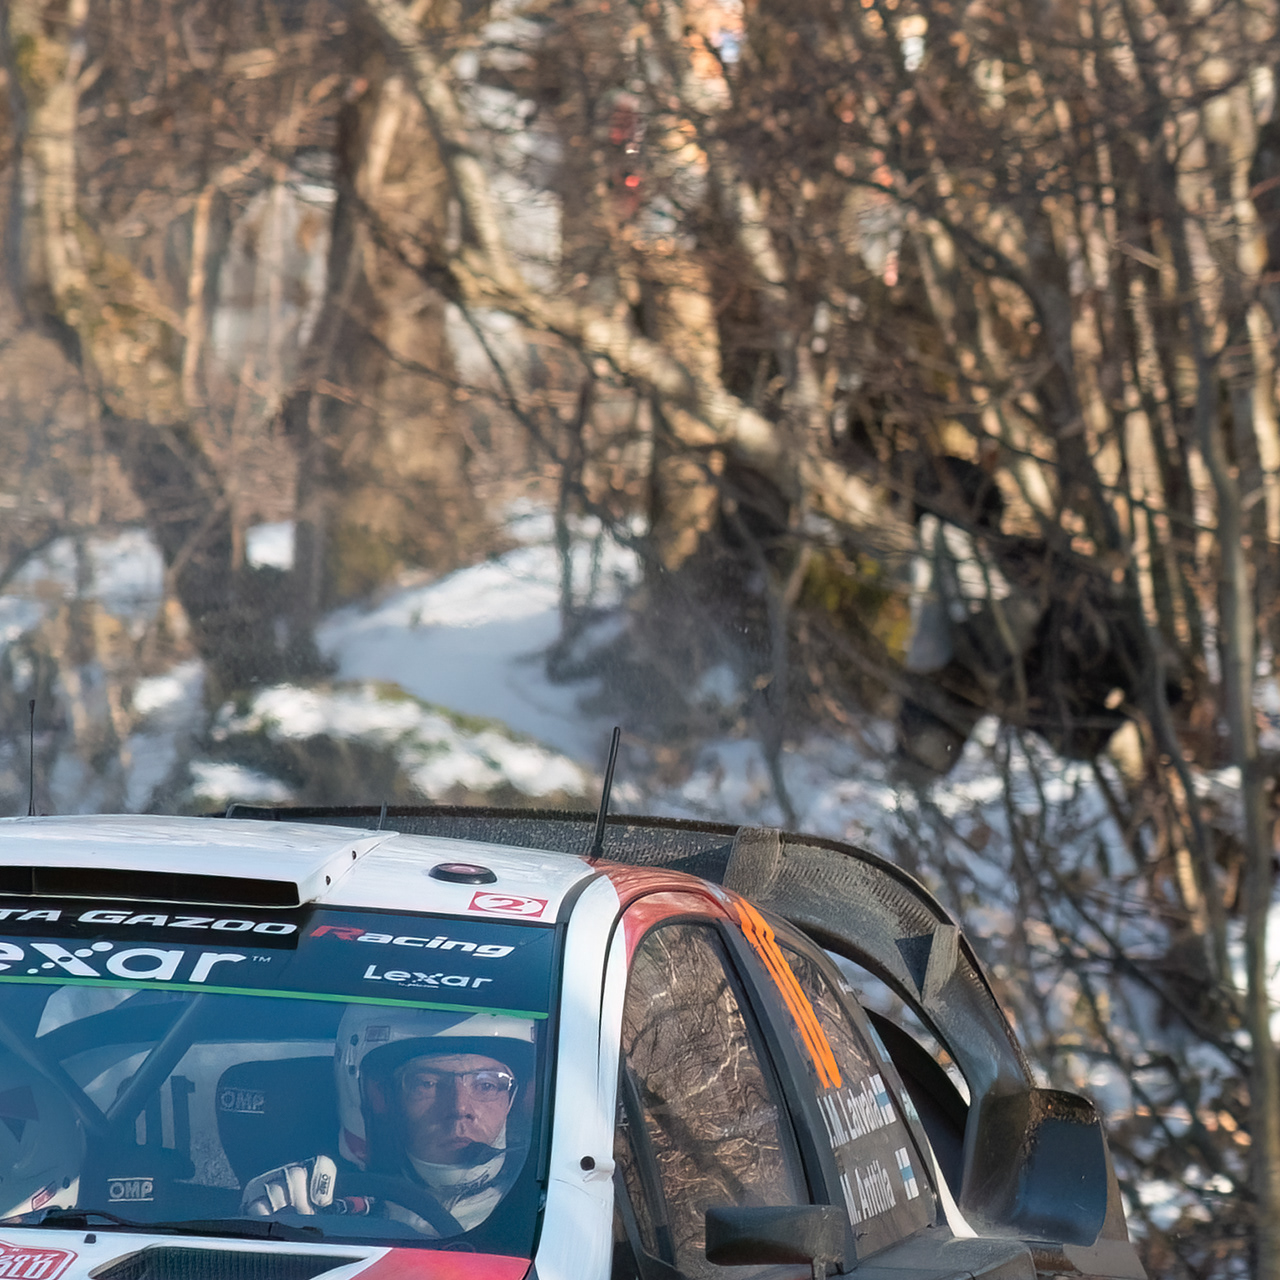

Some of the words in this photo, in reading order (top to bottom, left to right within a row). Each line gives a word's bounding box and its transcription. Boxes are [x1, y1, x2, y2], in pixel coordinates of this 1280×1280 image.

[77, 909, 297, 936] GAZOO
[310, 925, 515, 958] Racing
[363, 964, 493, 988] Lexar
[110, 1182, 153, 1199] OMP
